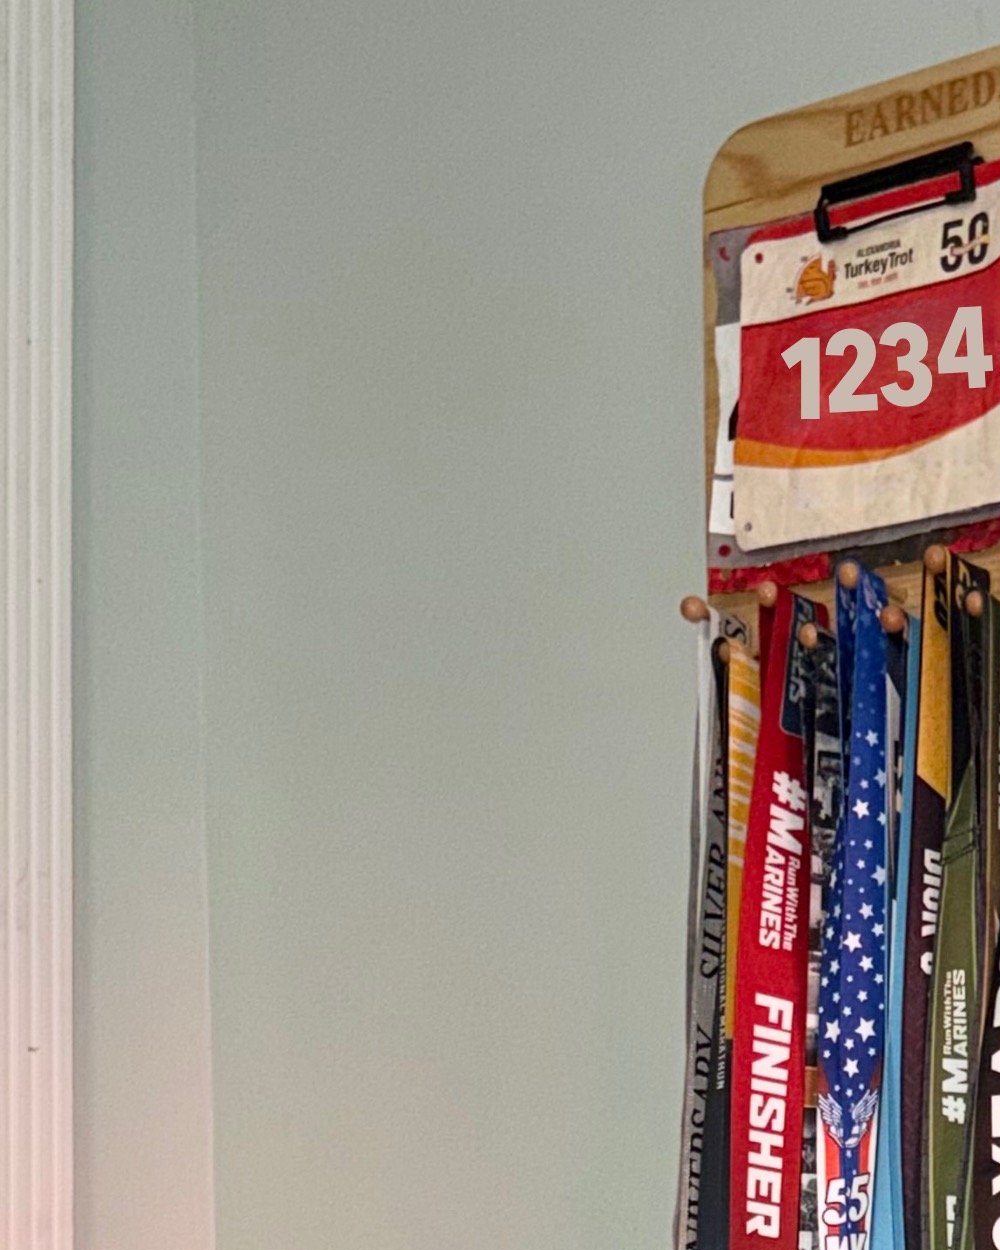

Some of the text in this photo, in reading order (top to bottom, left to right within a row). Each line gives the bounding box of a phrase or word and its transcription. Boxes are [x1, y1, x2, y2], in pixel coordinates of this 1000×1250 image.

[940, 211, 990, 273] 50
[780, 305, 994, 420] 1234
[758, 770, 807, 950] #MARINES
[745, 992, 795, 1240] FINISHER
[942, 968, 967, 1125] #MARINES
